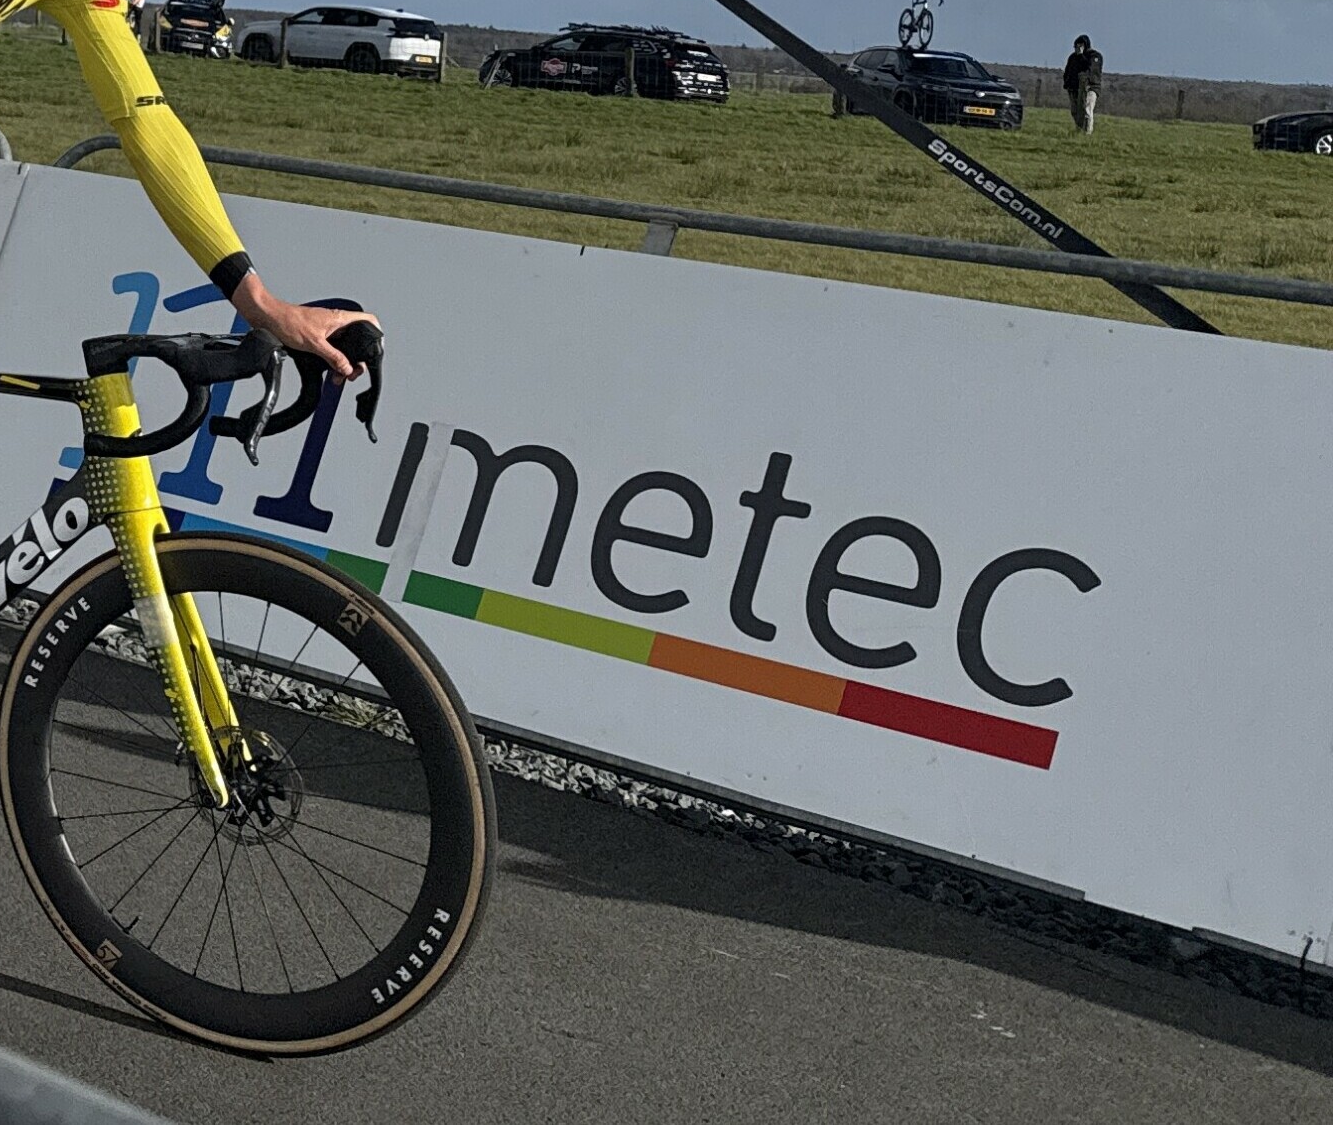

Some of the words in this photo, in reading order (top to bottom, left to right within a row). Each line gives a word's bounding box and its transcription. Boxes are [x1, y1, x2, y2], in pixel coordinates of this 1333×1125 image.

[135, 95, 167, 107] SR
[927, 138, 1065, 240] SportsCom.nl
[376, 422, 1102, 708] metec
[24, 597, 91, 689] RESERVE
[97, 944, 120, 964] 57
[370, 906, 451, 1006] RESERVE
